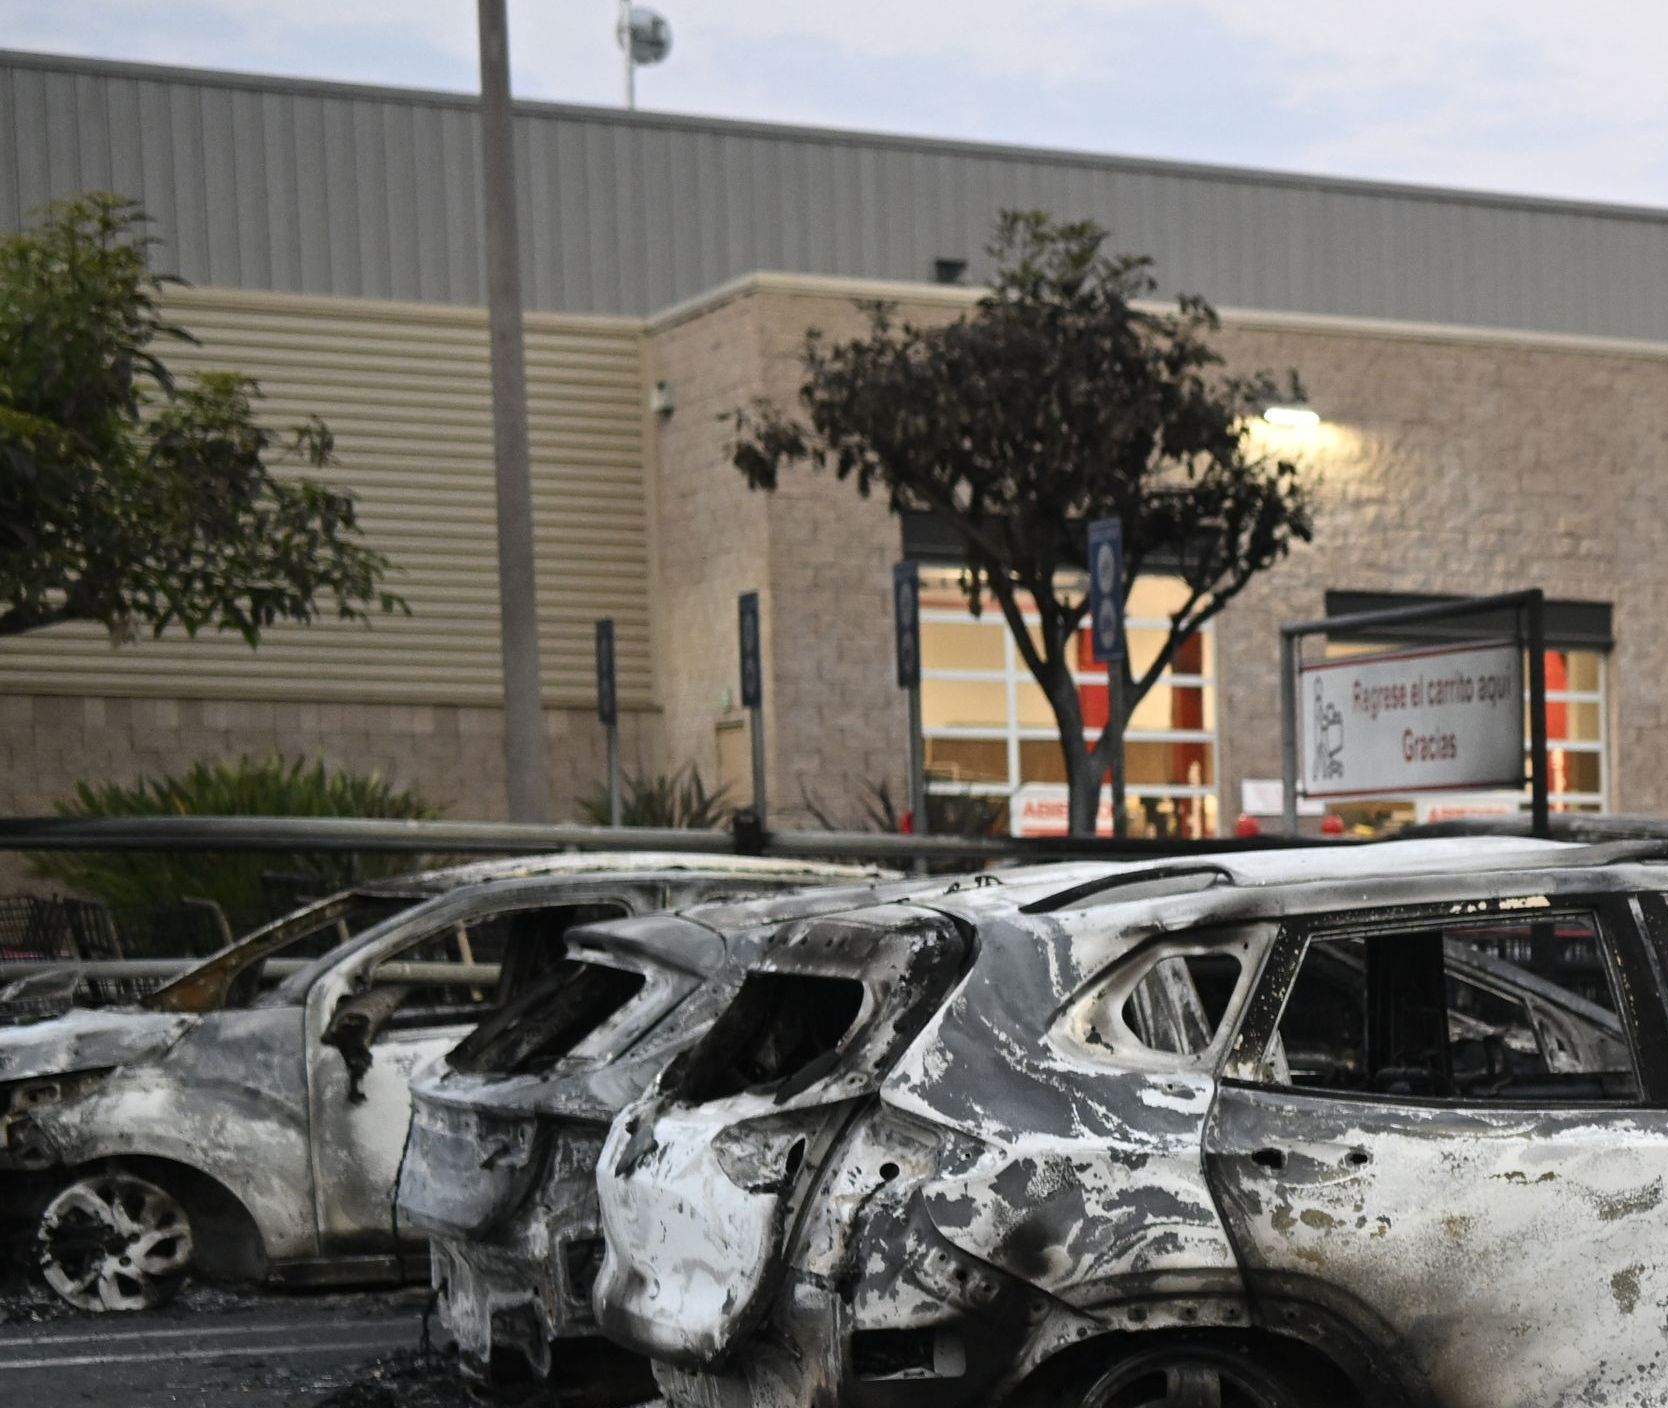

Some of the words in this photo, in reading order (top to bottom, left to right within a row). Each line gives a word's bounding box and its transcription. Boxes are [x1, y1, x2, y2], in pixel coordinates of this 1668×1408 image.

[1353, 679, 1408, 720] Regrese
[1410, 673, 1424, 708] el
[1427, 670, 1474, 706] carrito
[1402, 724, 1458, 763] Gracias
